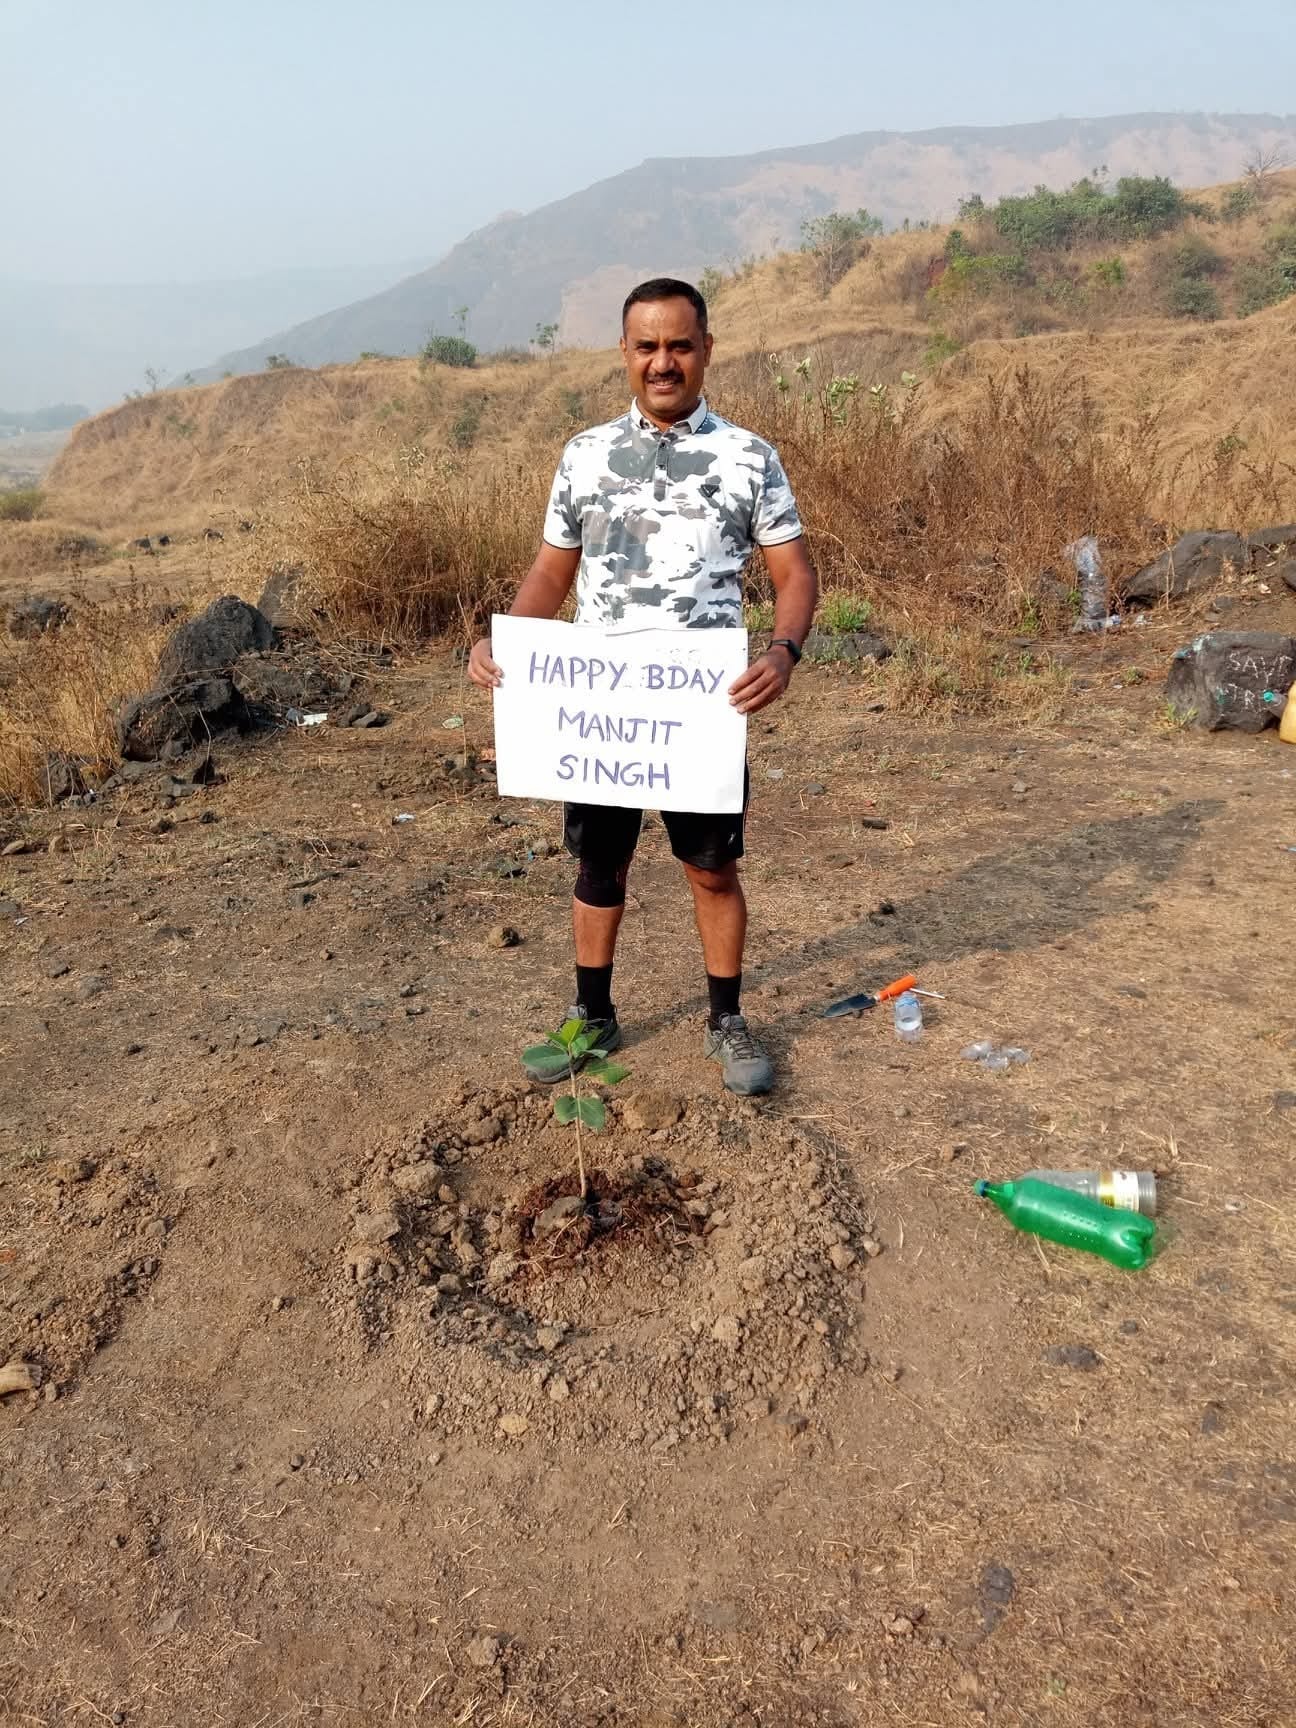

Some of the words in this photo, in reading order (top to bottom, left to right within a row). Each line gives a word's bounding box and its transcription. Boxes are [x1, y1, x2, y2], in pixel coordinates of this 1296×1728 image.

[529, 651, 627, 690] HAPPY
[645, 664, 725, 694] BDAY
[558, 706, 683, 745] MANJIT
[556, 754, 671, 790] SINGH
